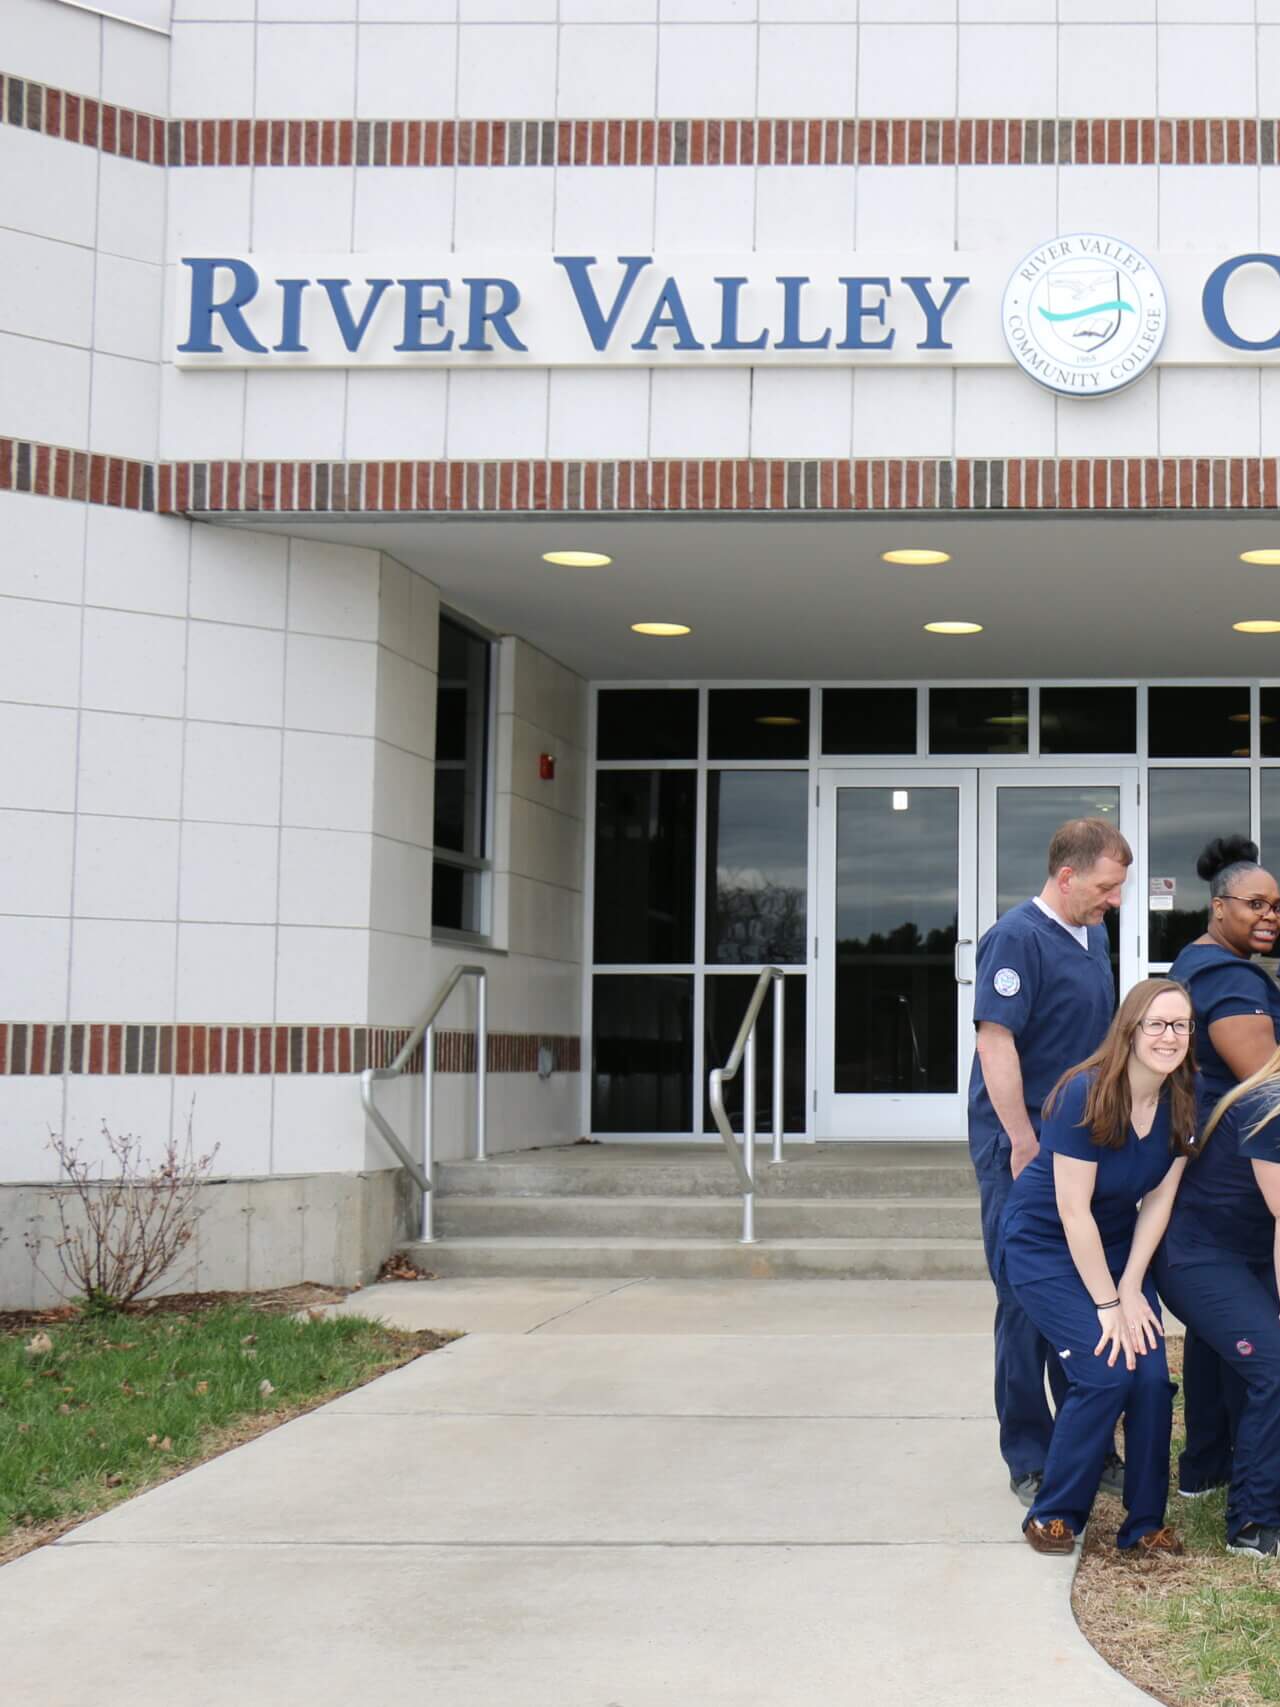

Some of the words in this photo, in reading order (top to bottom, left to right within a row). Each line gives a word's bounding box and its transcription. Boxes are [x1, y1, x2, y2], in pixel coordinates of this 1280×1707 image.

[1020, 241, 1072, 281] RIVER
[1080, 238, 1146, 275] VALLEY
[177, 257, 527, 353] RIVER
[554, 256, 970, 351] VALLEY
[1008, 314, 1101, 387] COMMUNITY
[1109, 307, 1162, 380] COLLEGE
